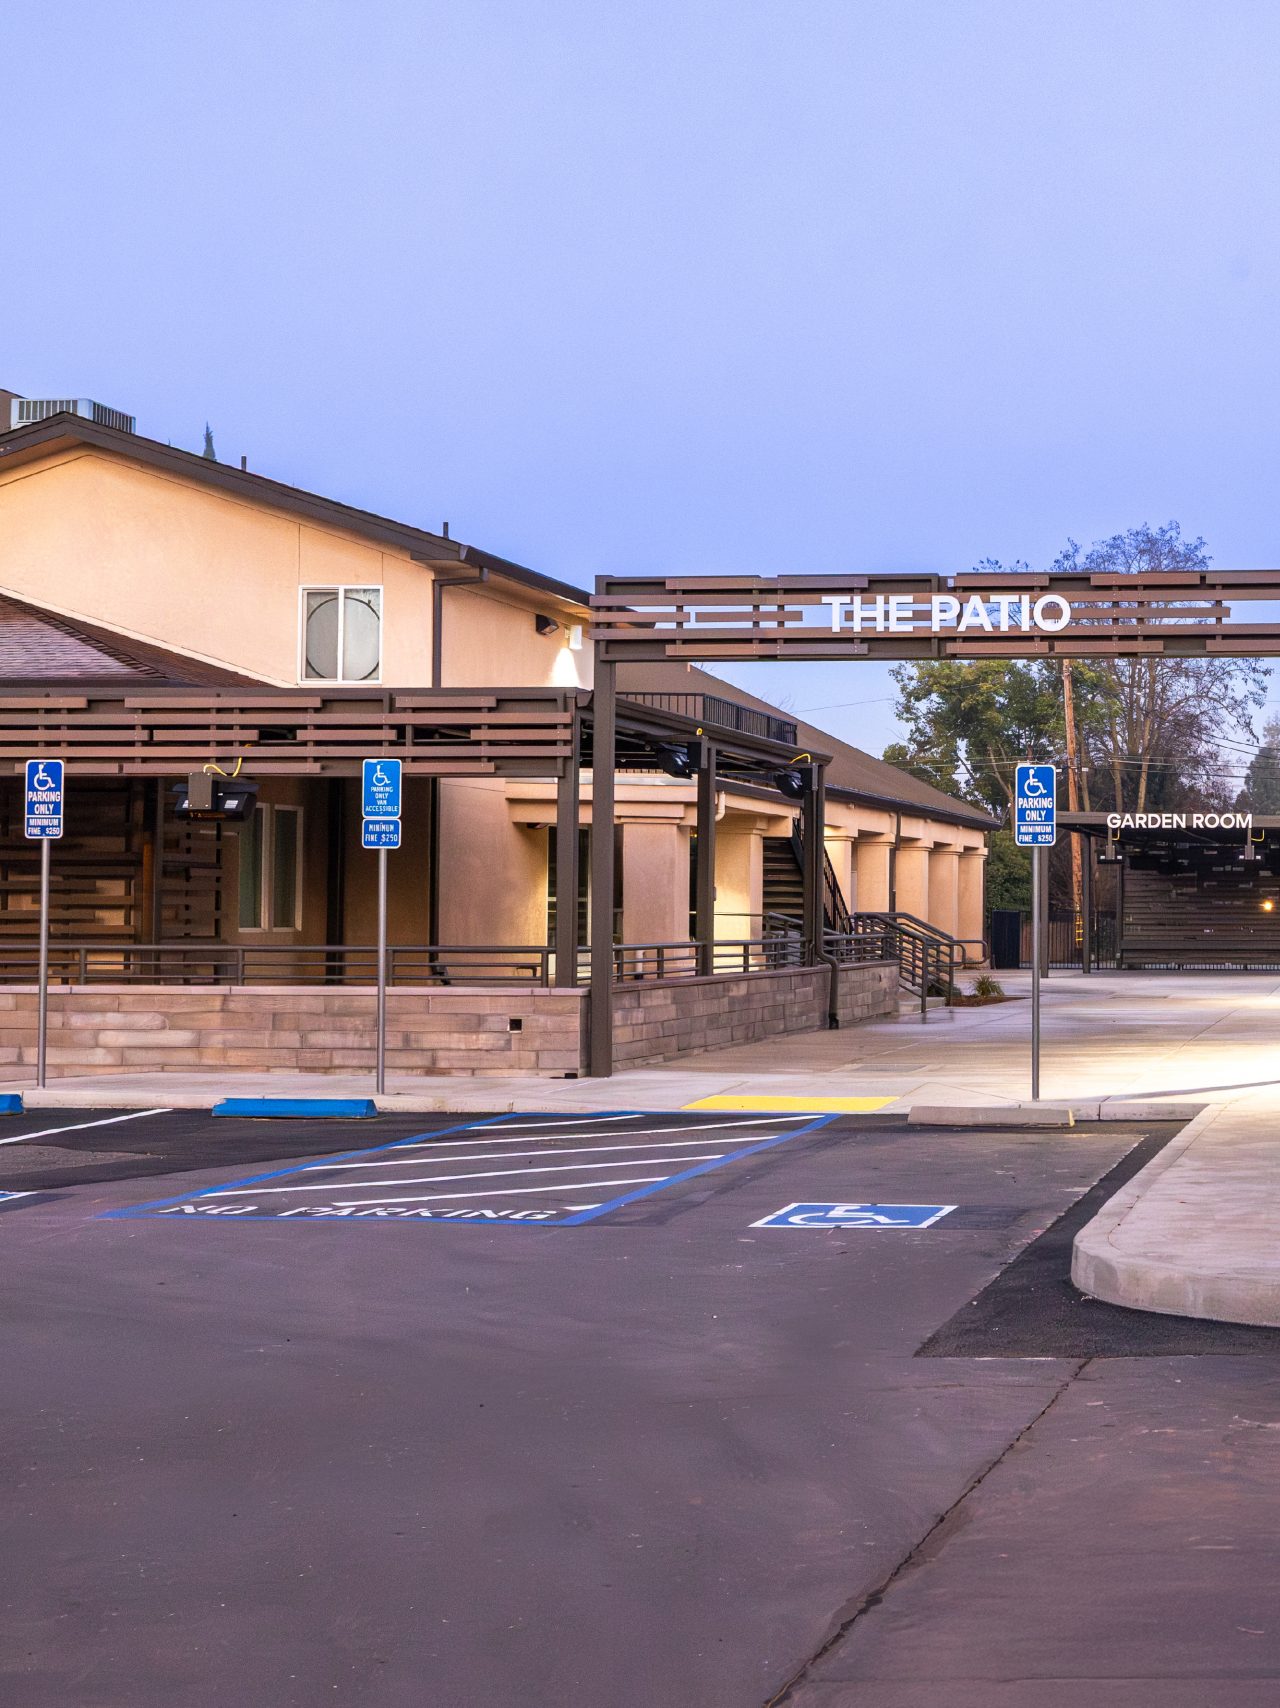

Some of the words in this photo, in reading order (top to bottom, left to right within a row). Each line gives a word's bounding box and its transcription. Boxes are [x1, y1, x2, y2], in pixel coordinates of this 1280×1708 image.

[821, 595, 914, 633] THE
[931, 594, 1072, 633] PATIO
[28, 791, 60, 802] PARKING
[1018, 797, 1053, 809] PARKING
[34, 803, 54, 815] ONLY
[1025, 810, 1047, 821] ONLY
[1106, 813, 1187, 829] GARDEN
[1192, 813, 1253, 829] ROOM
[29, 818, 59, 826] MINIMUM
[27, 827, 41, 835] FINE
[45, 827, 60, 835] $250
[368, 824, 394, 832] MINIMUM
[1020, 825, 1052, 833] MINIMUM
[365, 834, 378, 842] FINE
[381, 834, 398, 842] $250
[1019, 834, 1033, 842] FINE
[1037, 834, 1053, 842] $250
[157, 1205, 259, 1215] NO
[277, 1206, 557, 1220] PARKING
